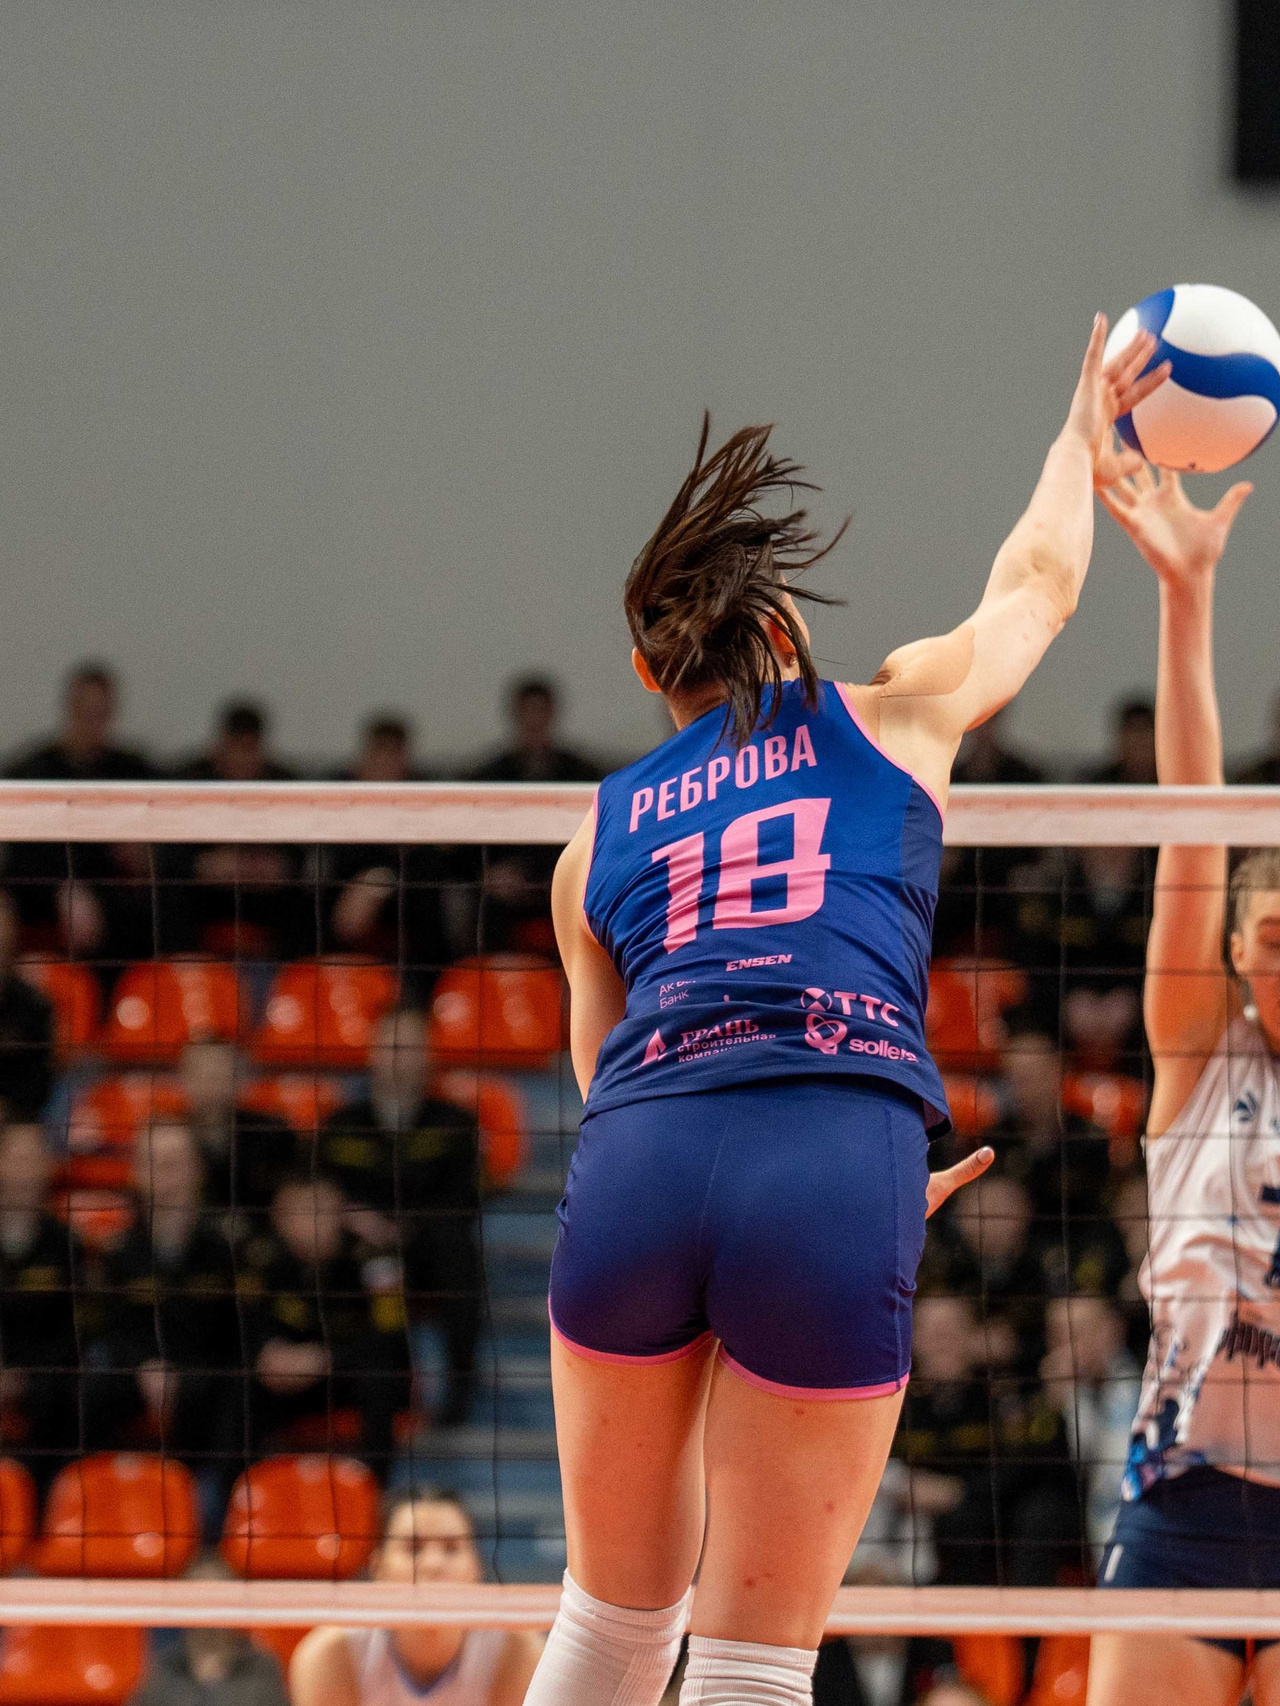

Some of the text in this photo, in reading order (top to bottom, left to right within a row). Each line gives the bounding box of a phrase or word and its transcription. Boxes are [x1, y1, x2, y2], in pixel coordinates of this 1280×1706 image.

[629, 724, 818, 834] РЕБРОВА
[651, 797, 832, 955] 18
[726, 954, 793, 972] ENSEN
[659, 989, 689, 1009] Банк
[676, 1033, 777, 1053] строительная
[680, 1019, 760, 1045] ГРАНЬ
[677, 1046, 737, 1064] компа
[848, 1038, 920, 1064] sollers
